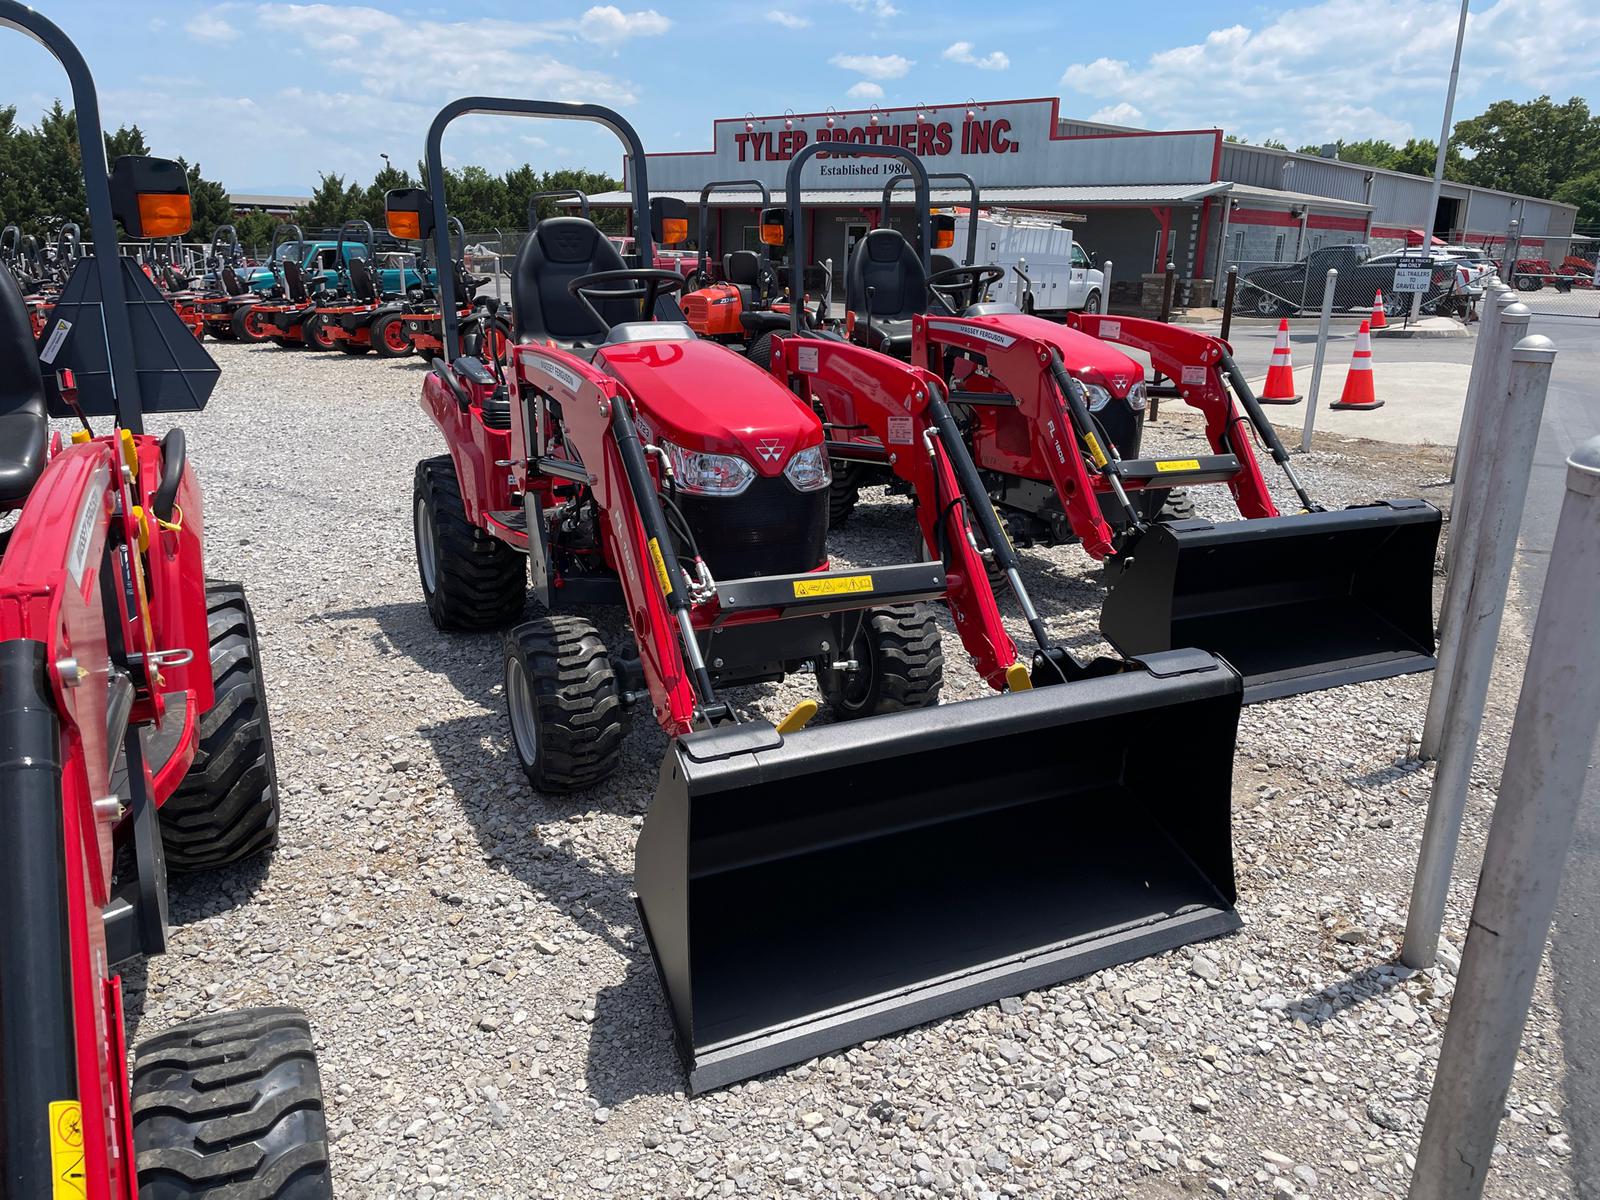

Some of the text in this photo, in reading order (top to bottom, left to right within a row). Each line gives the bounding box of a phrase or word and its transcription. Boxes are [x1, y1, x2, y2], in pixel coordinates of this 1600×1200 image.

[735, 119, 1020, 162] TYLER BROTHERS INC.
[820, 163, 908, 176] Established 1980
[960, 326, 1004, 343] MASSEY FERGUSON
[1047, 420, 1055, 438] FL
